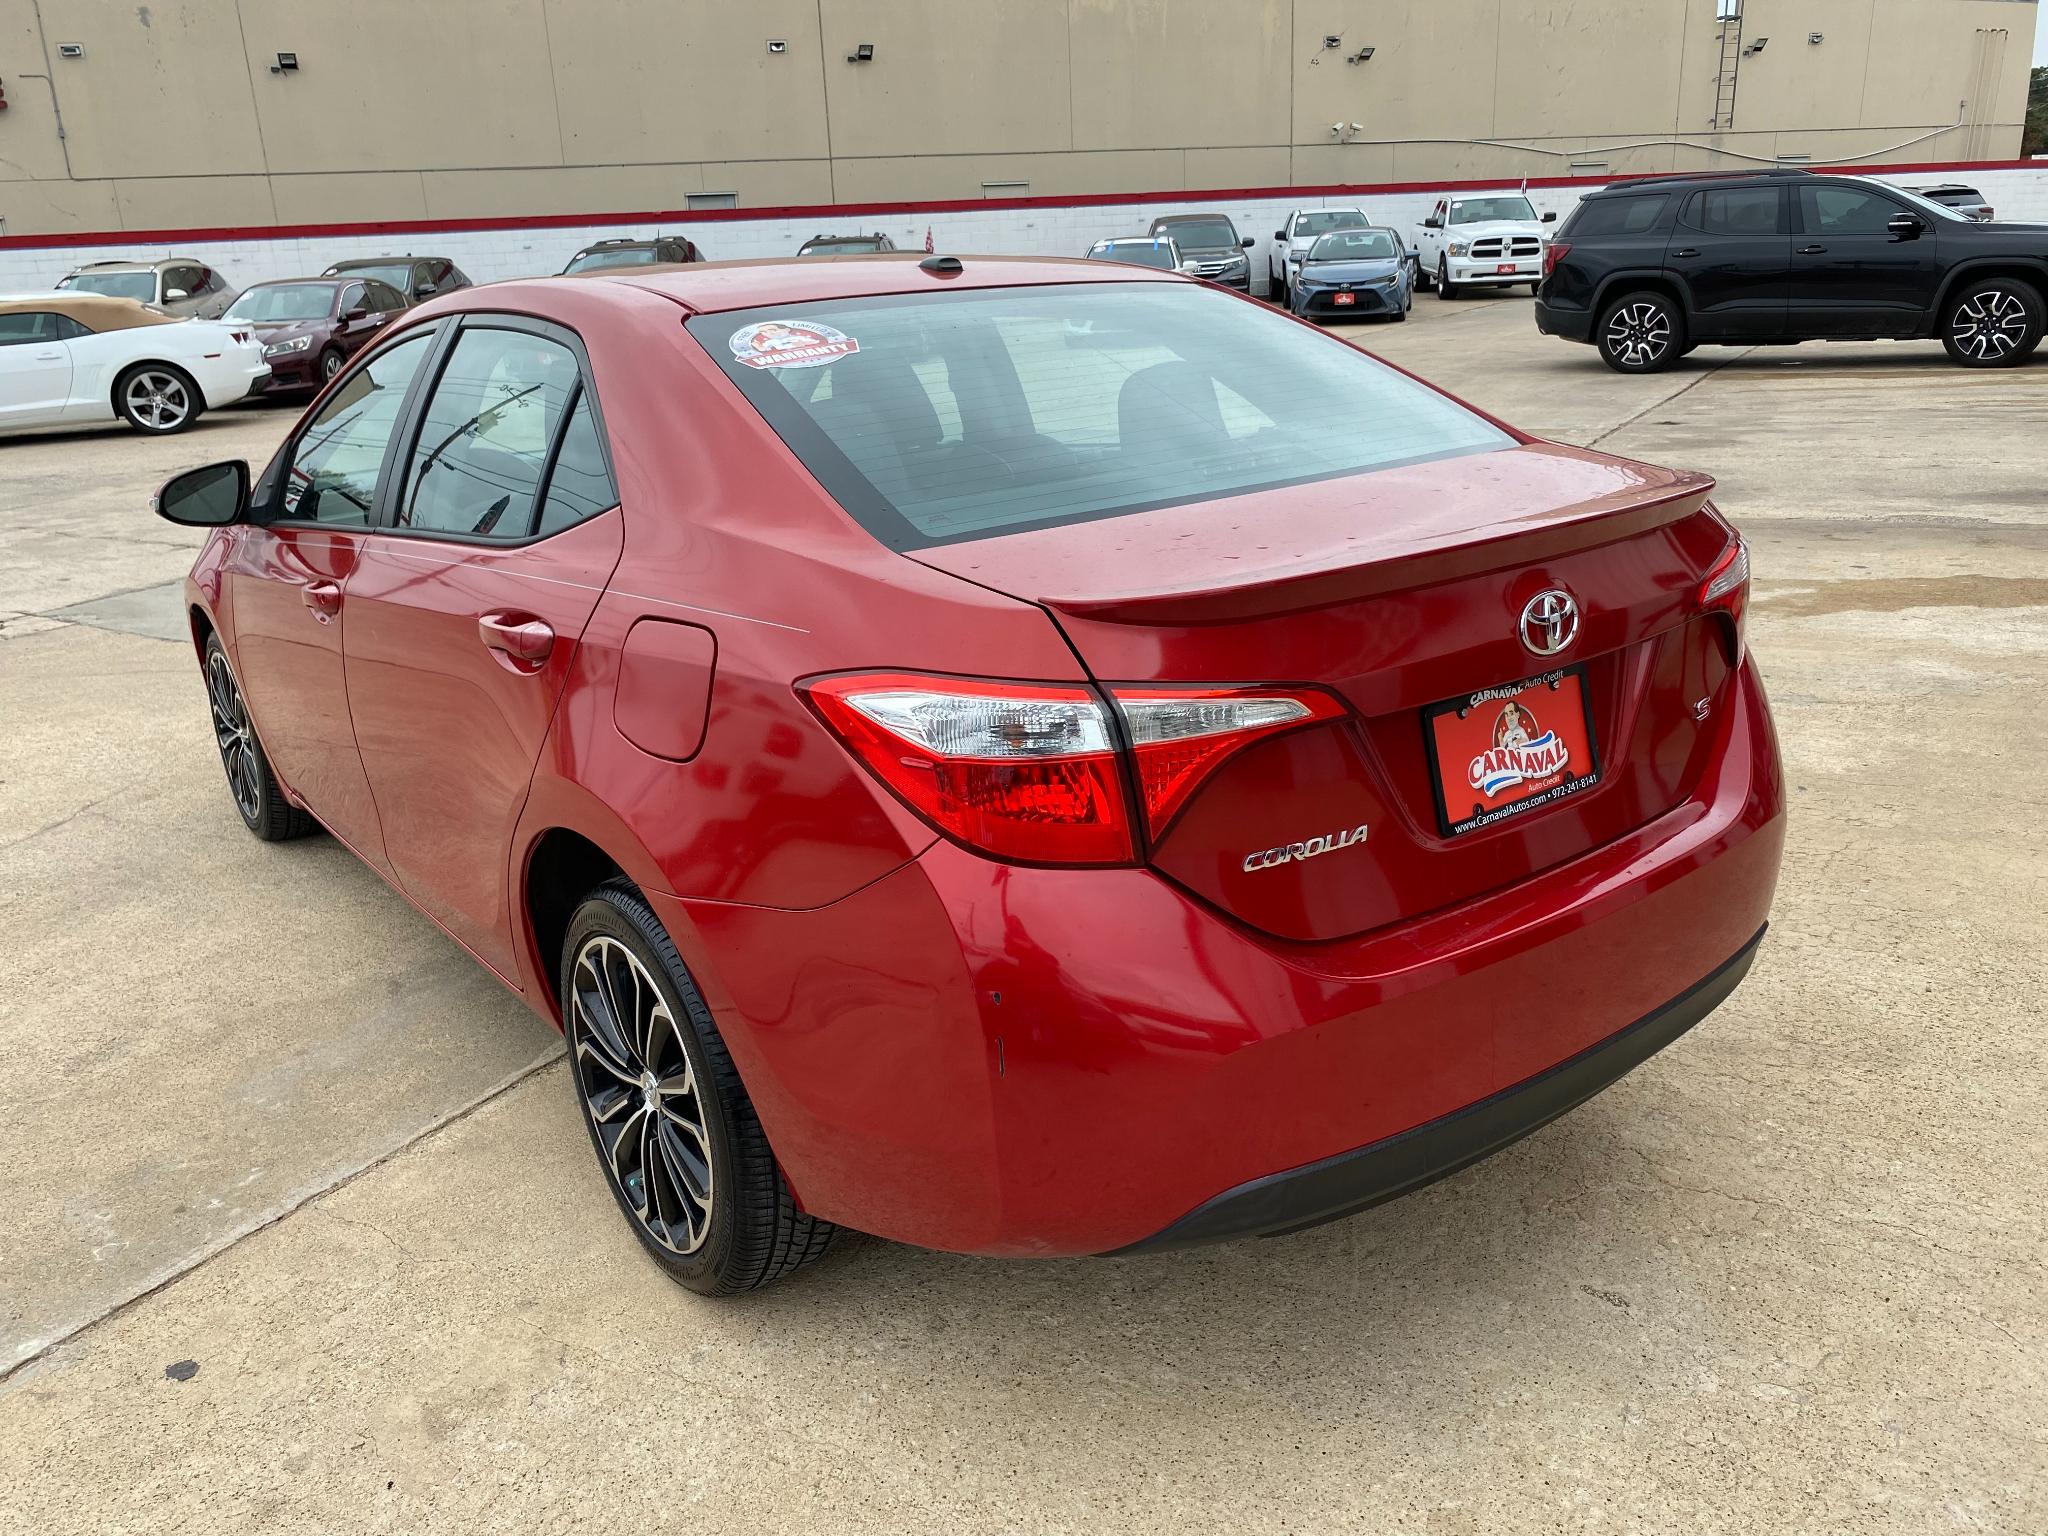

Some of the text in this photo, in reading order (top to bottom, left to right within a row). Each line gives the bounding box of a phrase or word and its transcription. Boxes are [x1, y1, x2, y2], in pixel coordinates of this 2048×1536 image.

[753, 342, 849, 366] WARRANTY
[1470, 669, 1564, 706] CARNAVAL Auto Credit
[1695, 696, 1711, 721] S
[1468, 738, 1569, 787] CARNAVAL
[1527, 774, 1561, 793] Auto Credit
[1454, 774, 1598, 835] www.CarnavalAutos.com 972-241-8141
[1242, 824, 1368, 873] COROLLA
